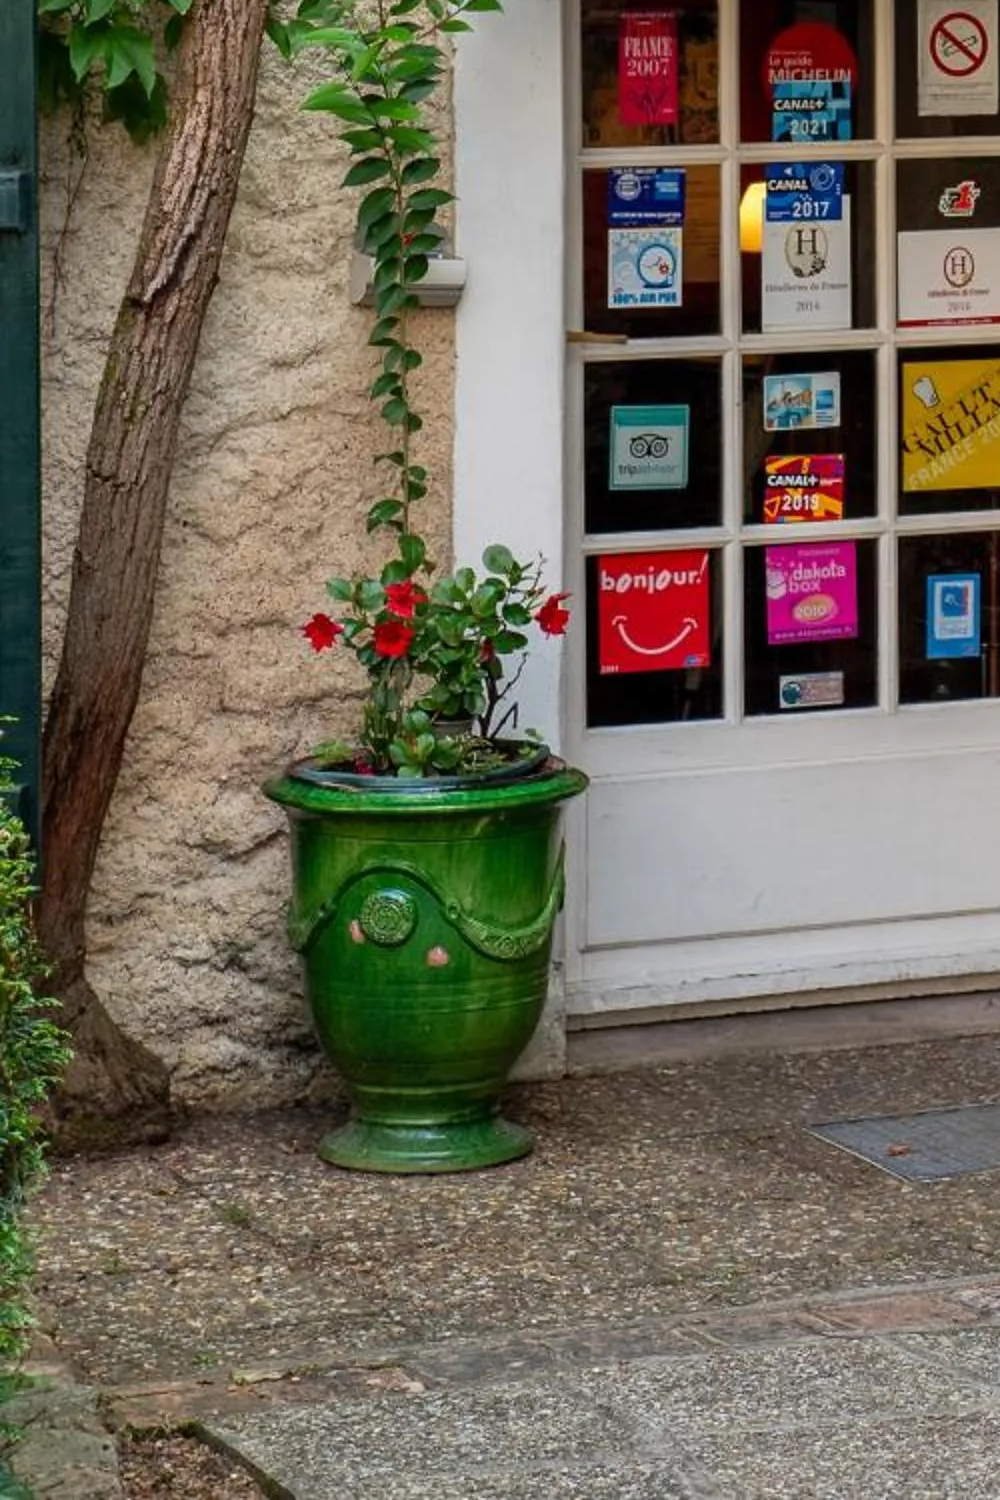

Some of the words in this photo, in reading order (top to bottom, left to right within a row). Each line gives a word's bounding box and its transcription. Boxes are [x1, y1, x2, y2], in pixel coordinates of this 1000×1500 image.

[624, 36, 673, 57] FRANCE
[627, 57, 669, 77] 2007
[768, 68, 851, 84] MICHELIN
[773, 99, 825, 111] CANAL+
[790, 119, 828, 135] 2021
[792, 201, 830, 223] 2017
[766, 475, 819, 487] CANAL+
[600, 553, 709, 594] bonjour!
[793, 560, 847, 581] dakota
[788, 576, 821, 593] box
